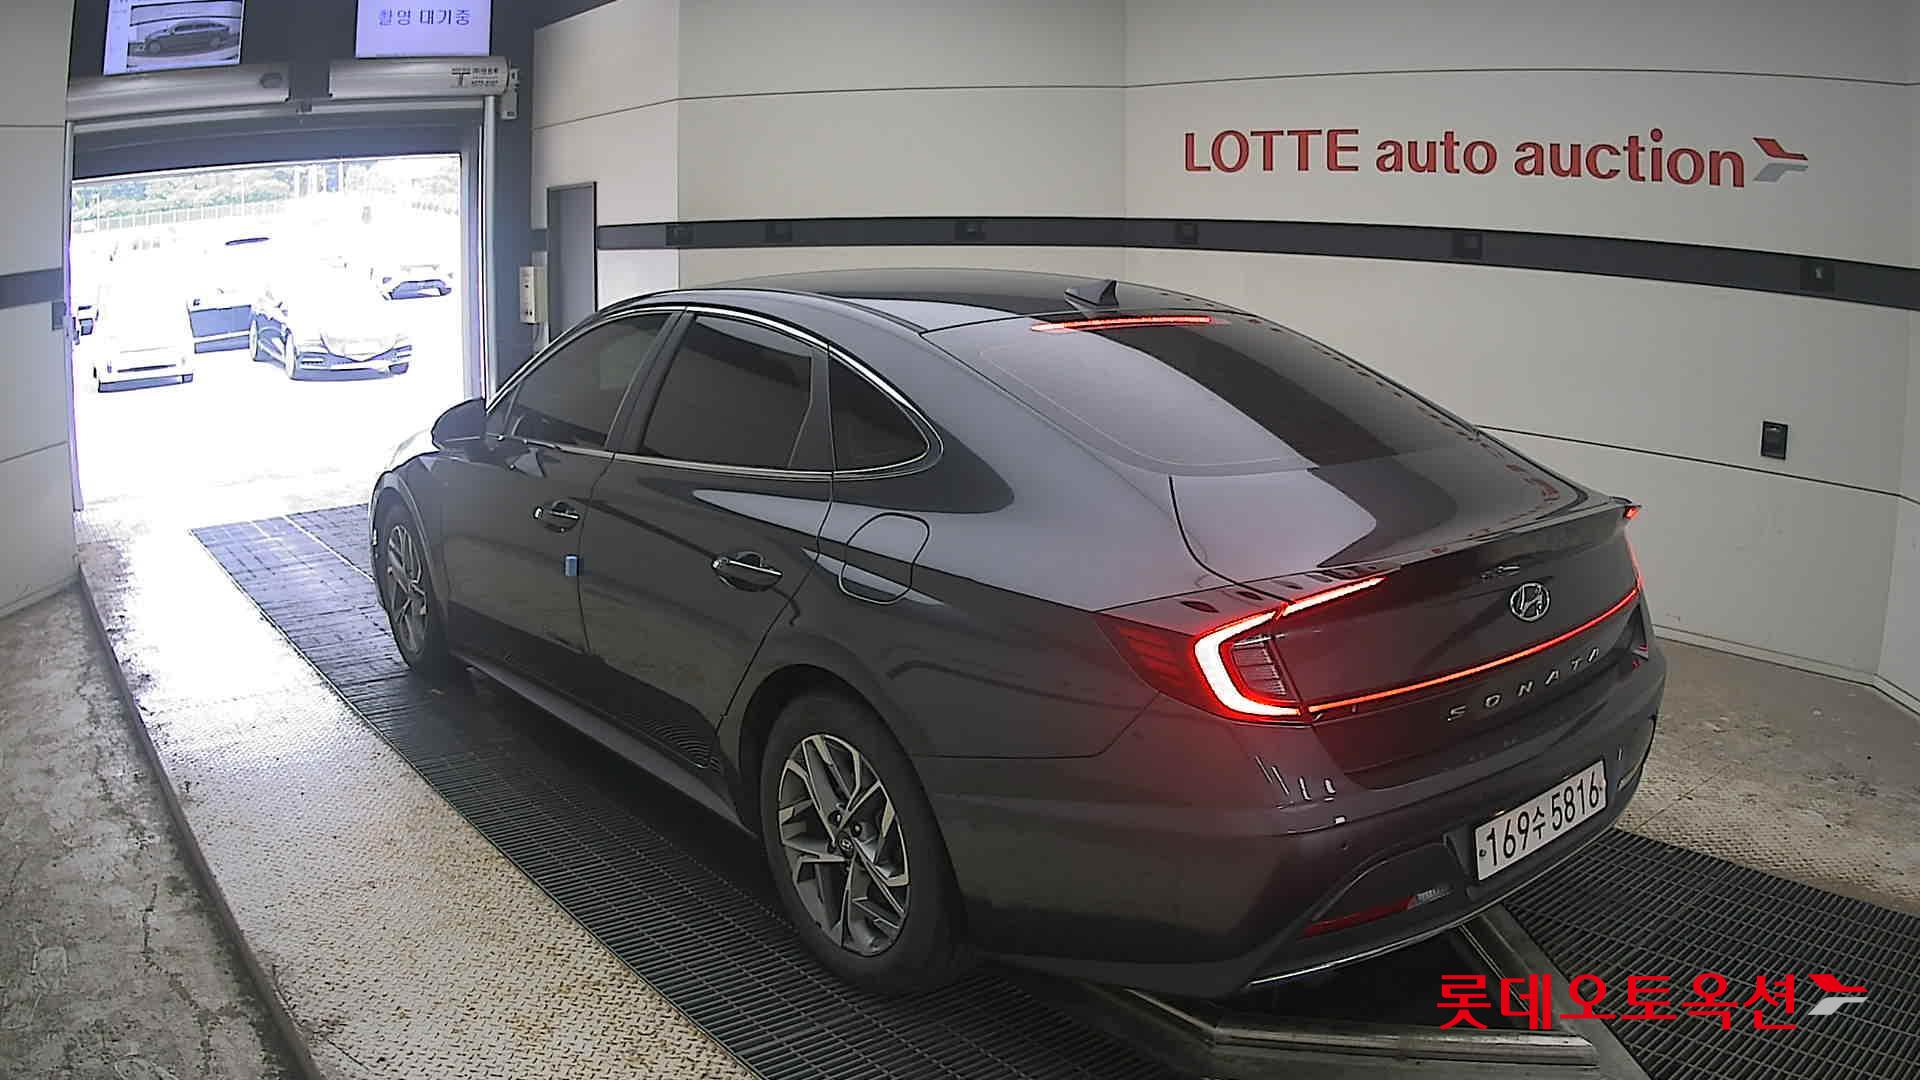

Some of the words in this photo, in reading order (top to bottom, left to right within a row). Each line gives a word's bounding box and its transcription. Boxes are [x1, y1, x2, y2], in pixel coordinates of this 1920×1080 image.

[419, 8, 471, 26] 대기중
[1184, 128, 1360, 173] LOTTE
[1375, 130, 1498, 174] auto
[1513, 128, 1745, 188] auction
[1447, 646, 1601, 722] SONATA
